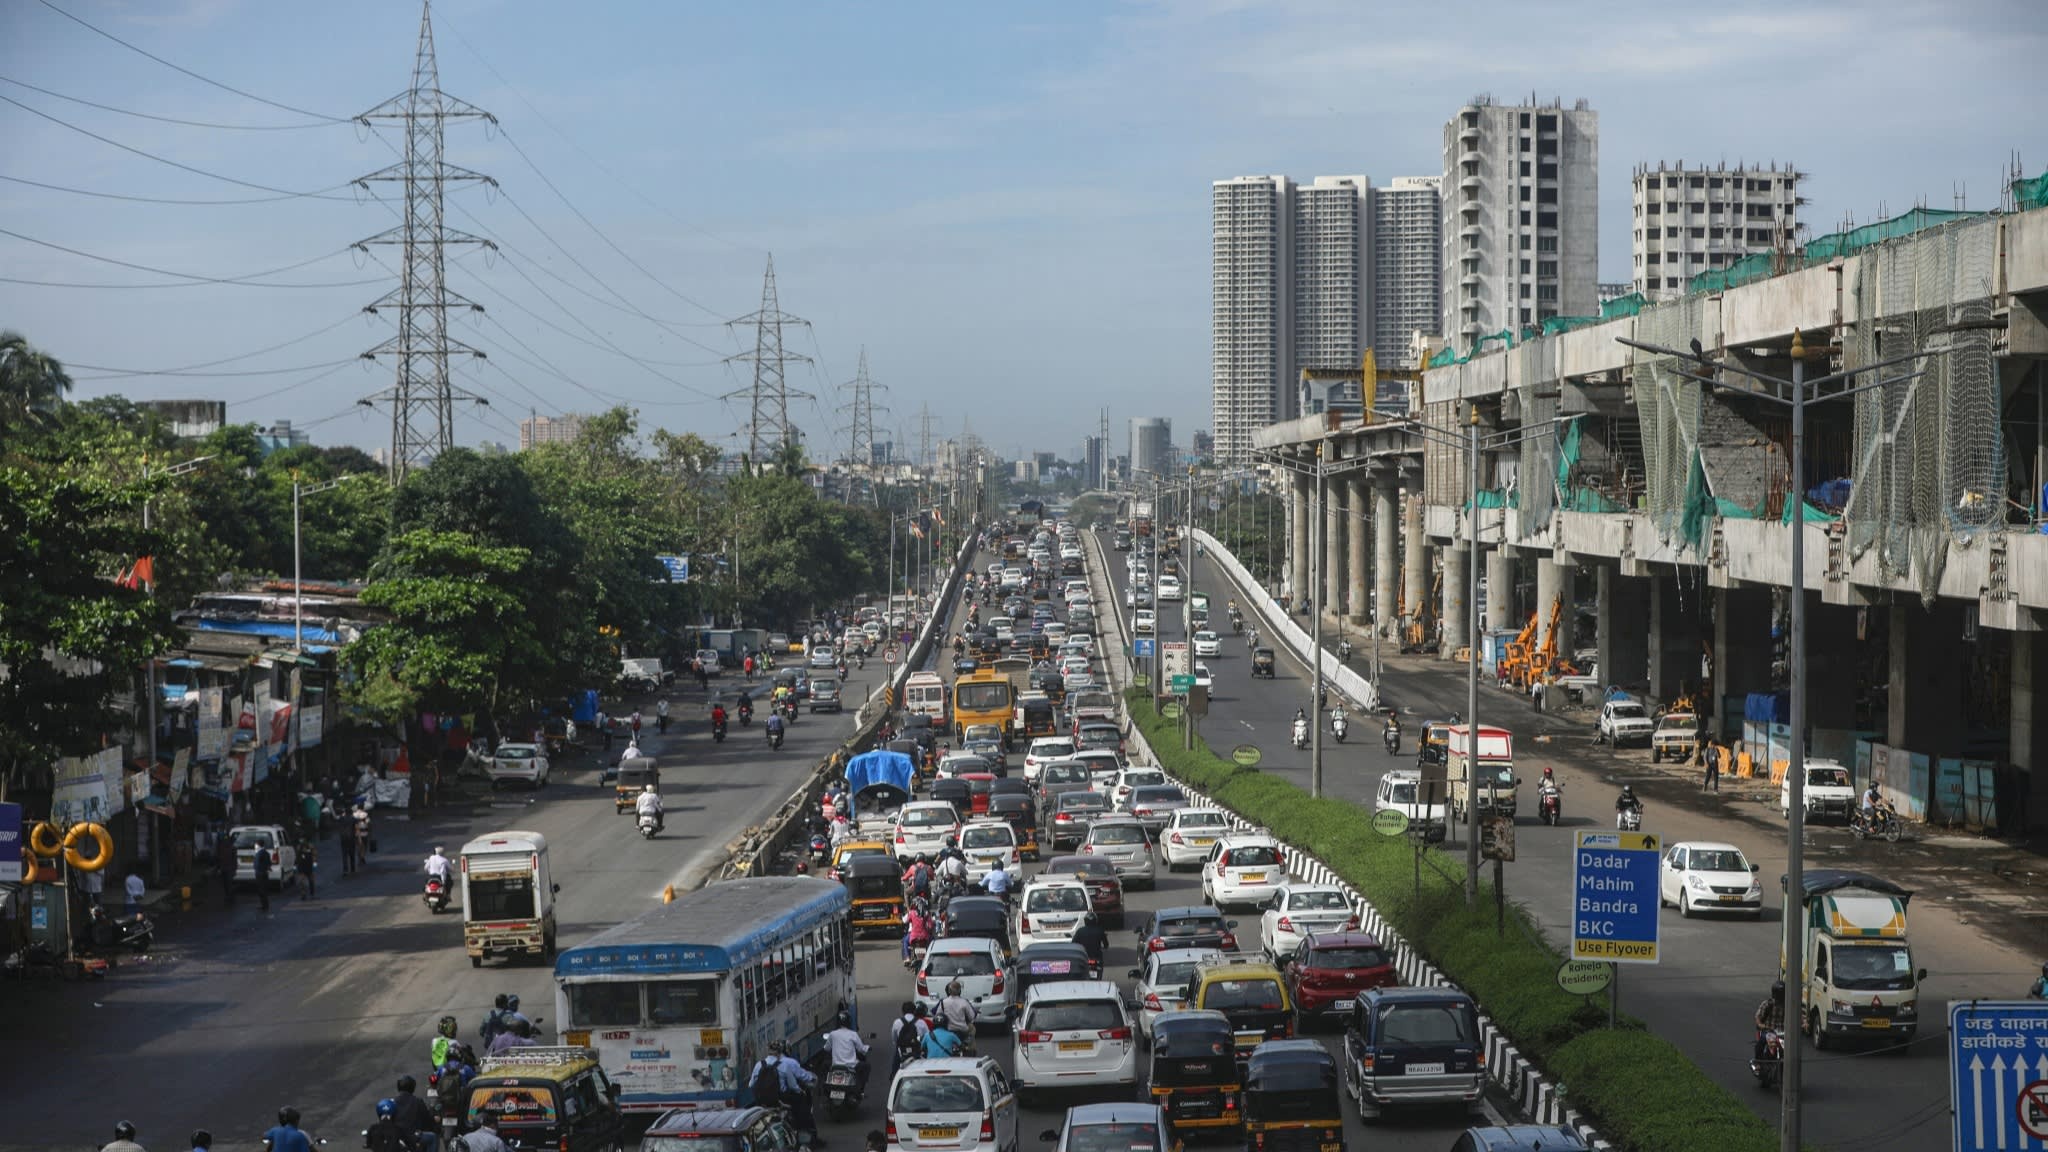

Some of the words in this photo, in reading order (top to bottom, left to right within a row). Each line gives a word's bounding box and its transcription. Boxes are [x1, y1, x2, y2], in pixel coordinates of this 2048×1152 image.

[1581, 853, 1631, 869] Dadar
[1580, 875, 1634, 891] Mahim
[1579, 898, 1638, 914] Bandra
[1579, 920, 1614, 935] BKC
[1578, 941, 1602, 953] Use
[1606, 942, 1653, 957] Flyover
[1568, 961, 1602, 972] Raheja
[1561, 972, 1609, 985] Residency
[1965, 1018, 1994, 1030] जड
[1960, 1032, 2028, 1049] डावीकडे
